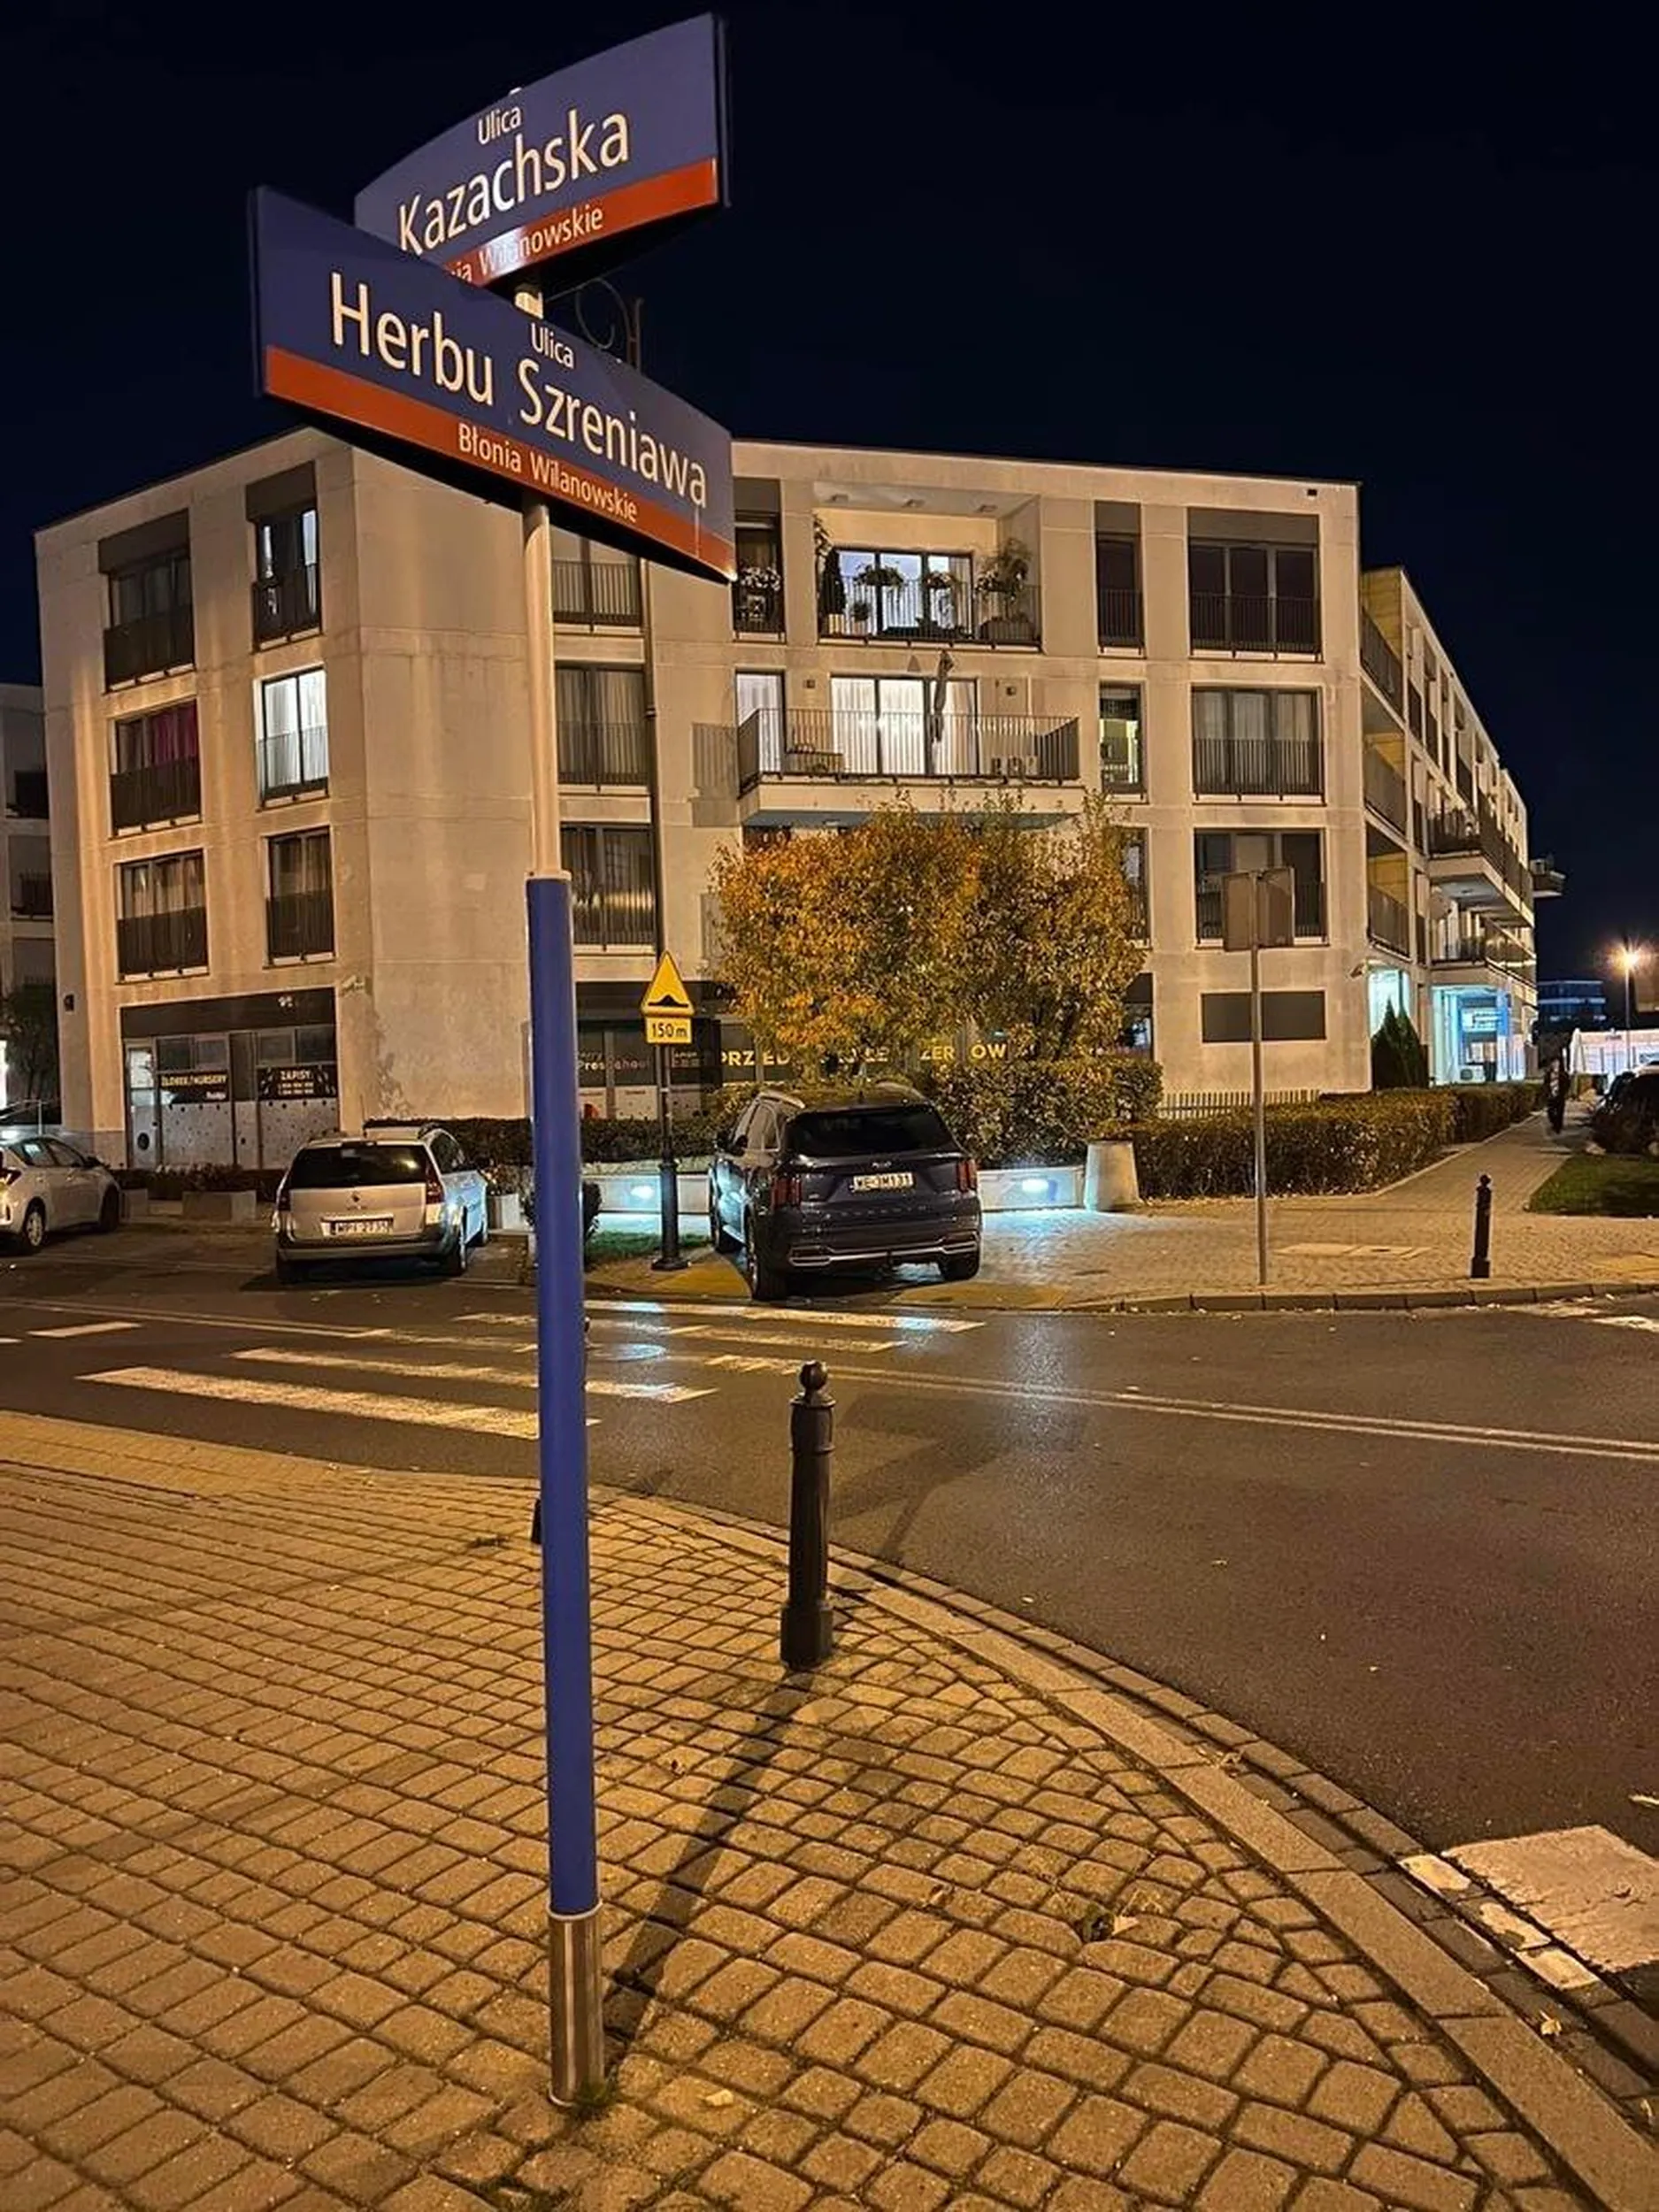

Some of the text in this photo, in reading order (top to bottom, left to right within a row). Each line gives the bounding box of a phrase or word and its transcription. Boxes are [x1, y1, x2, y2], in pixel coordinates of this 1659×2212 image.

[478, 106, 522, 144] Ulica
[400, 109, 629, 256] Kazachska
[332, 272, 706, 508] Herbu Szreniawa
[531, 322, 574, 369] Ulica
[458, 422, 637, 523] Błonia Wilanowskie
